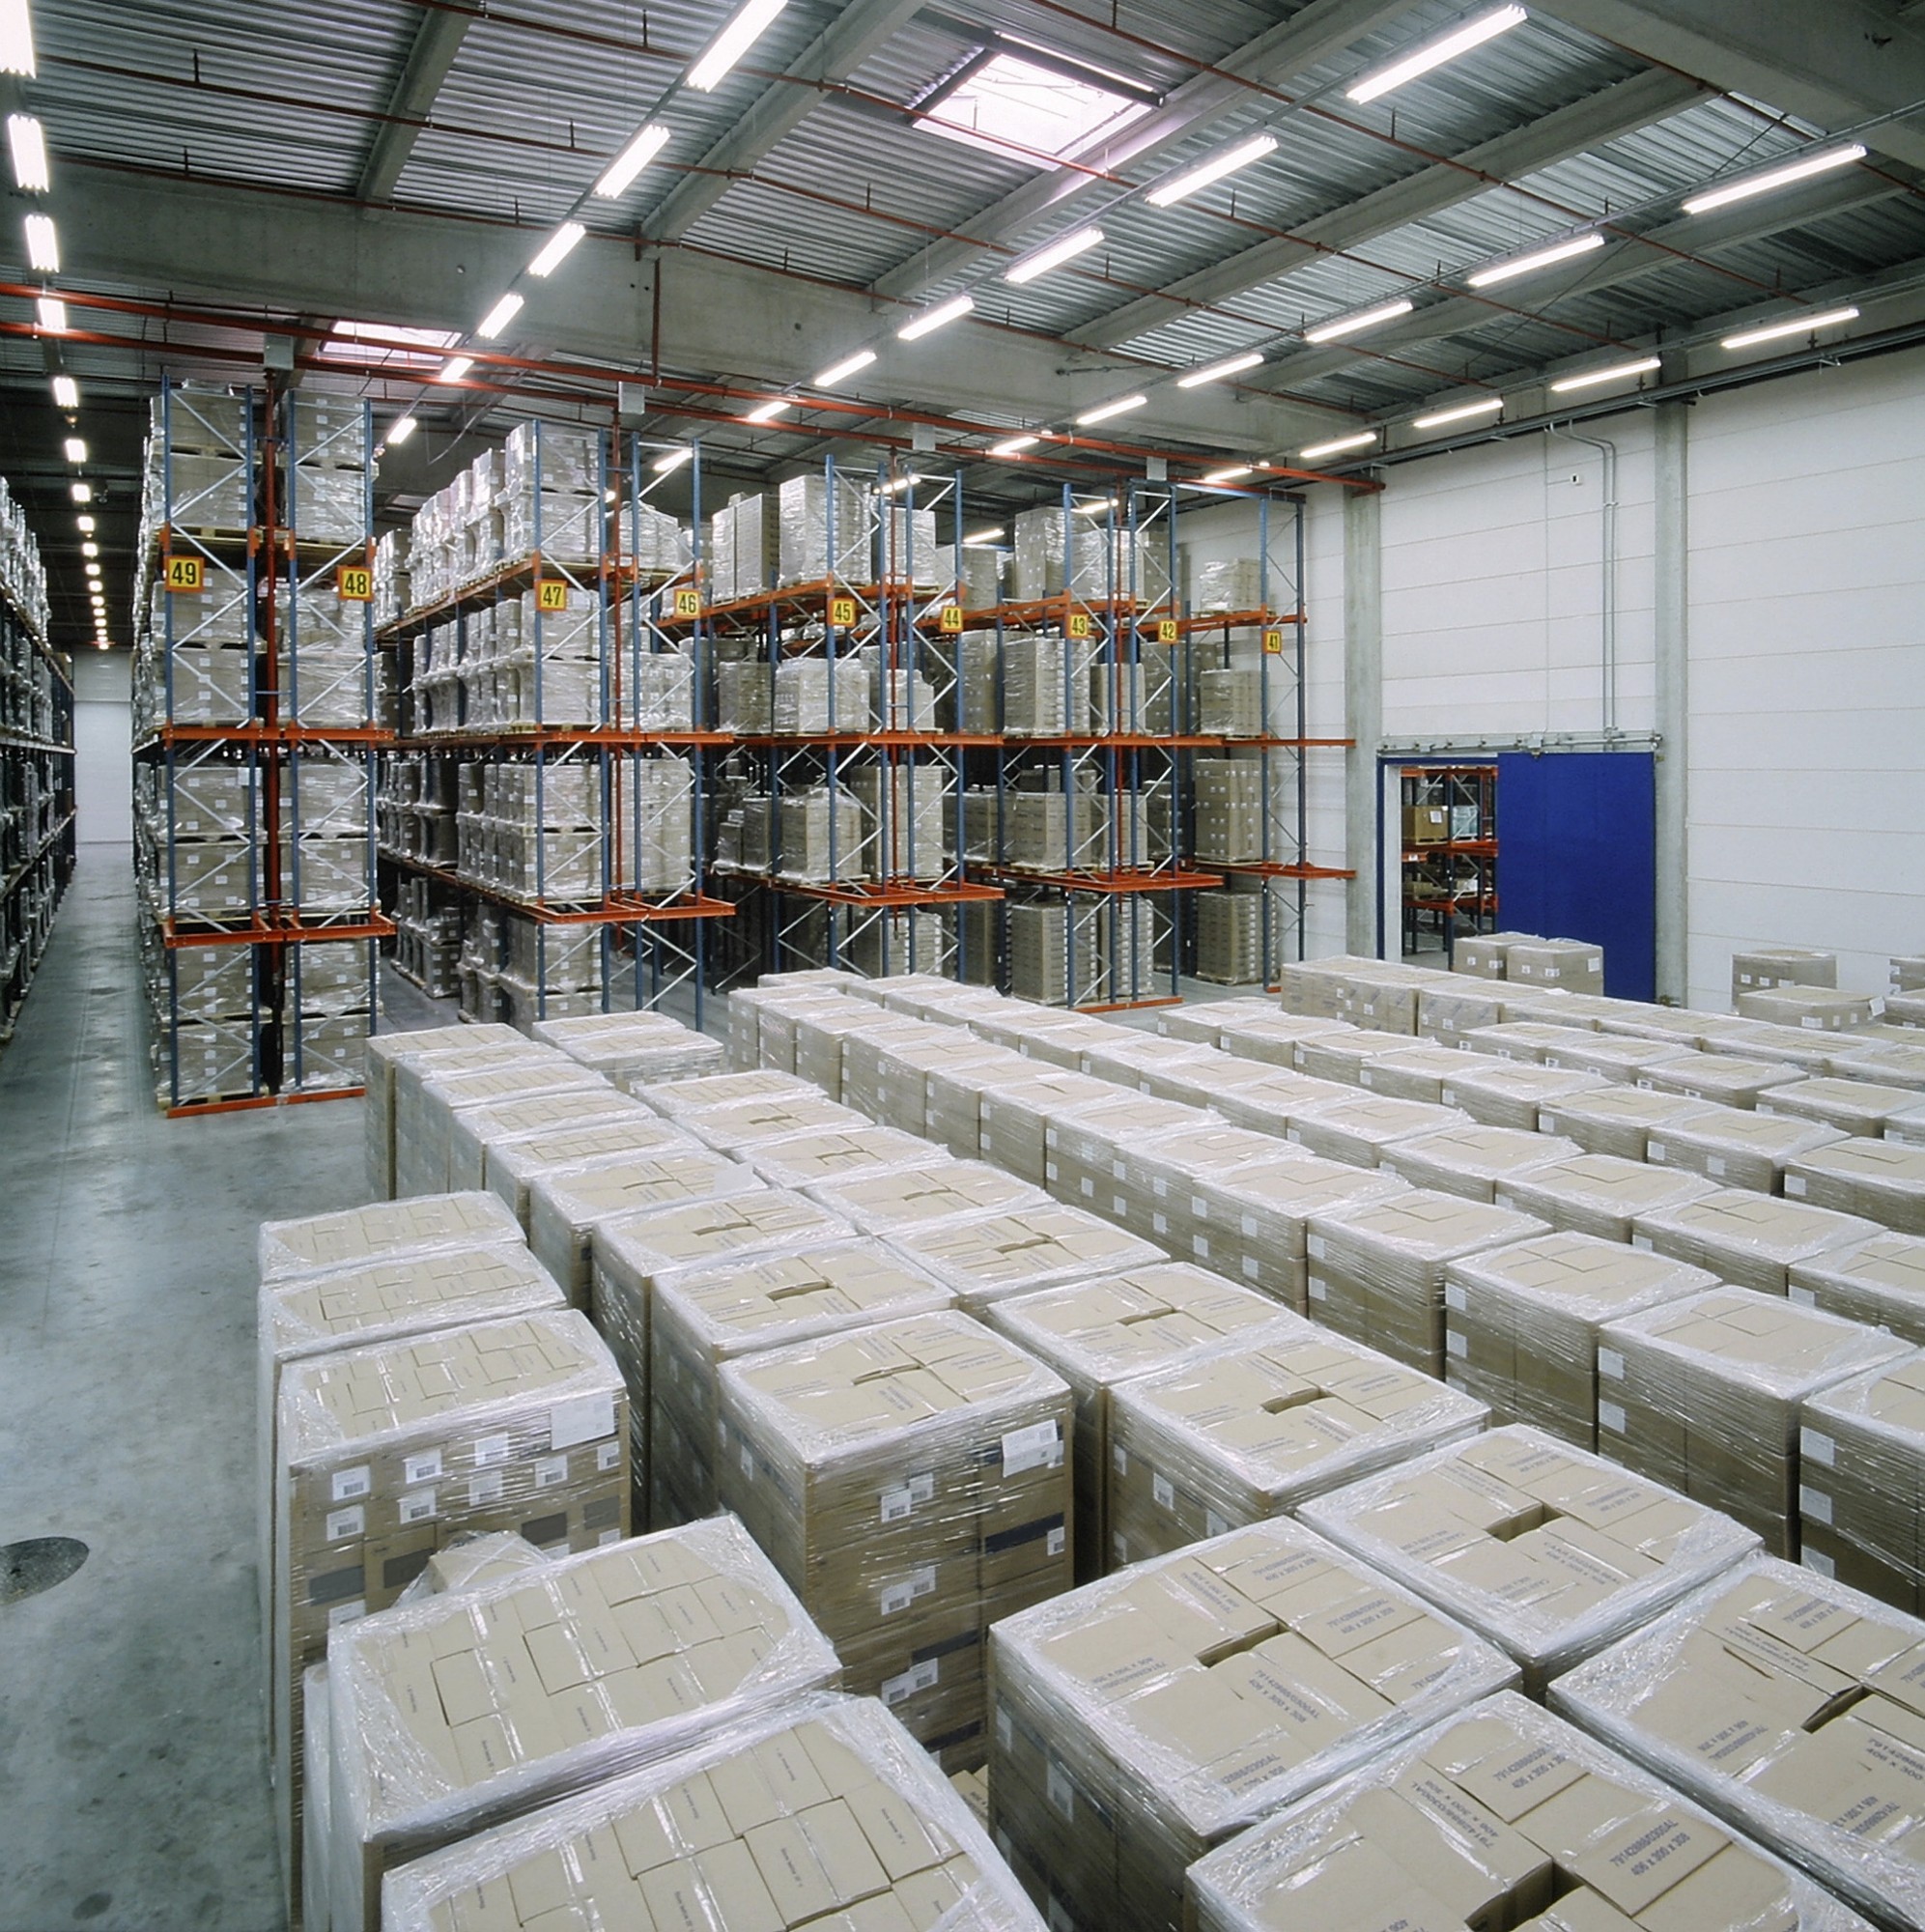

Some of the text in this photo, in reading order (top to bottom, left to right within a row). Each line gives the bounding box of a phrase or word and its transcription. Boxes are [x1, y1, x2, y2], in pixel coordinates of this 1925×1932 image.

[172, 562, 196, 584] 49
[345, 574, 367, 595] 48
[543, 586, 562, 606] 47
[678, 594, 696, 613] 46
[835, 603, 851, 621] 45
[944, 610, 959, 626] 44
[1072, 617, 1086, 634] 43
[1161, 623, 1175, 639] 42
[1268, 634, 1278, 649] 41
